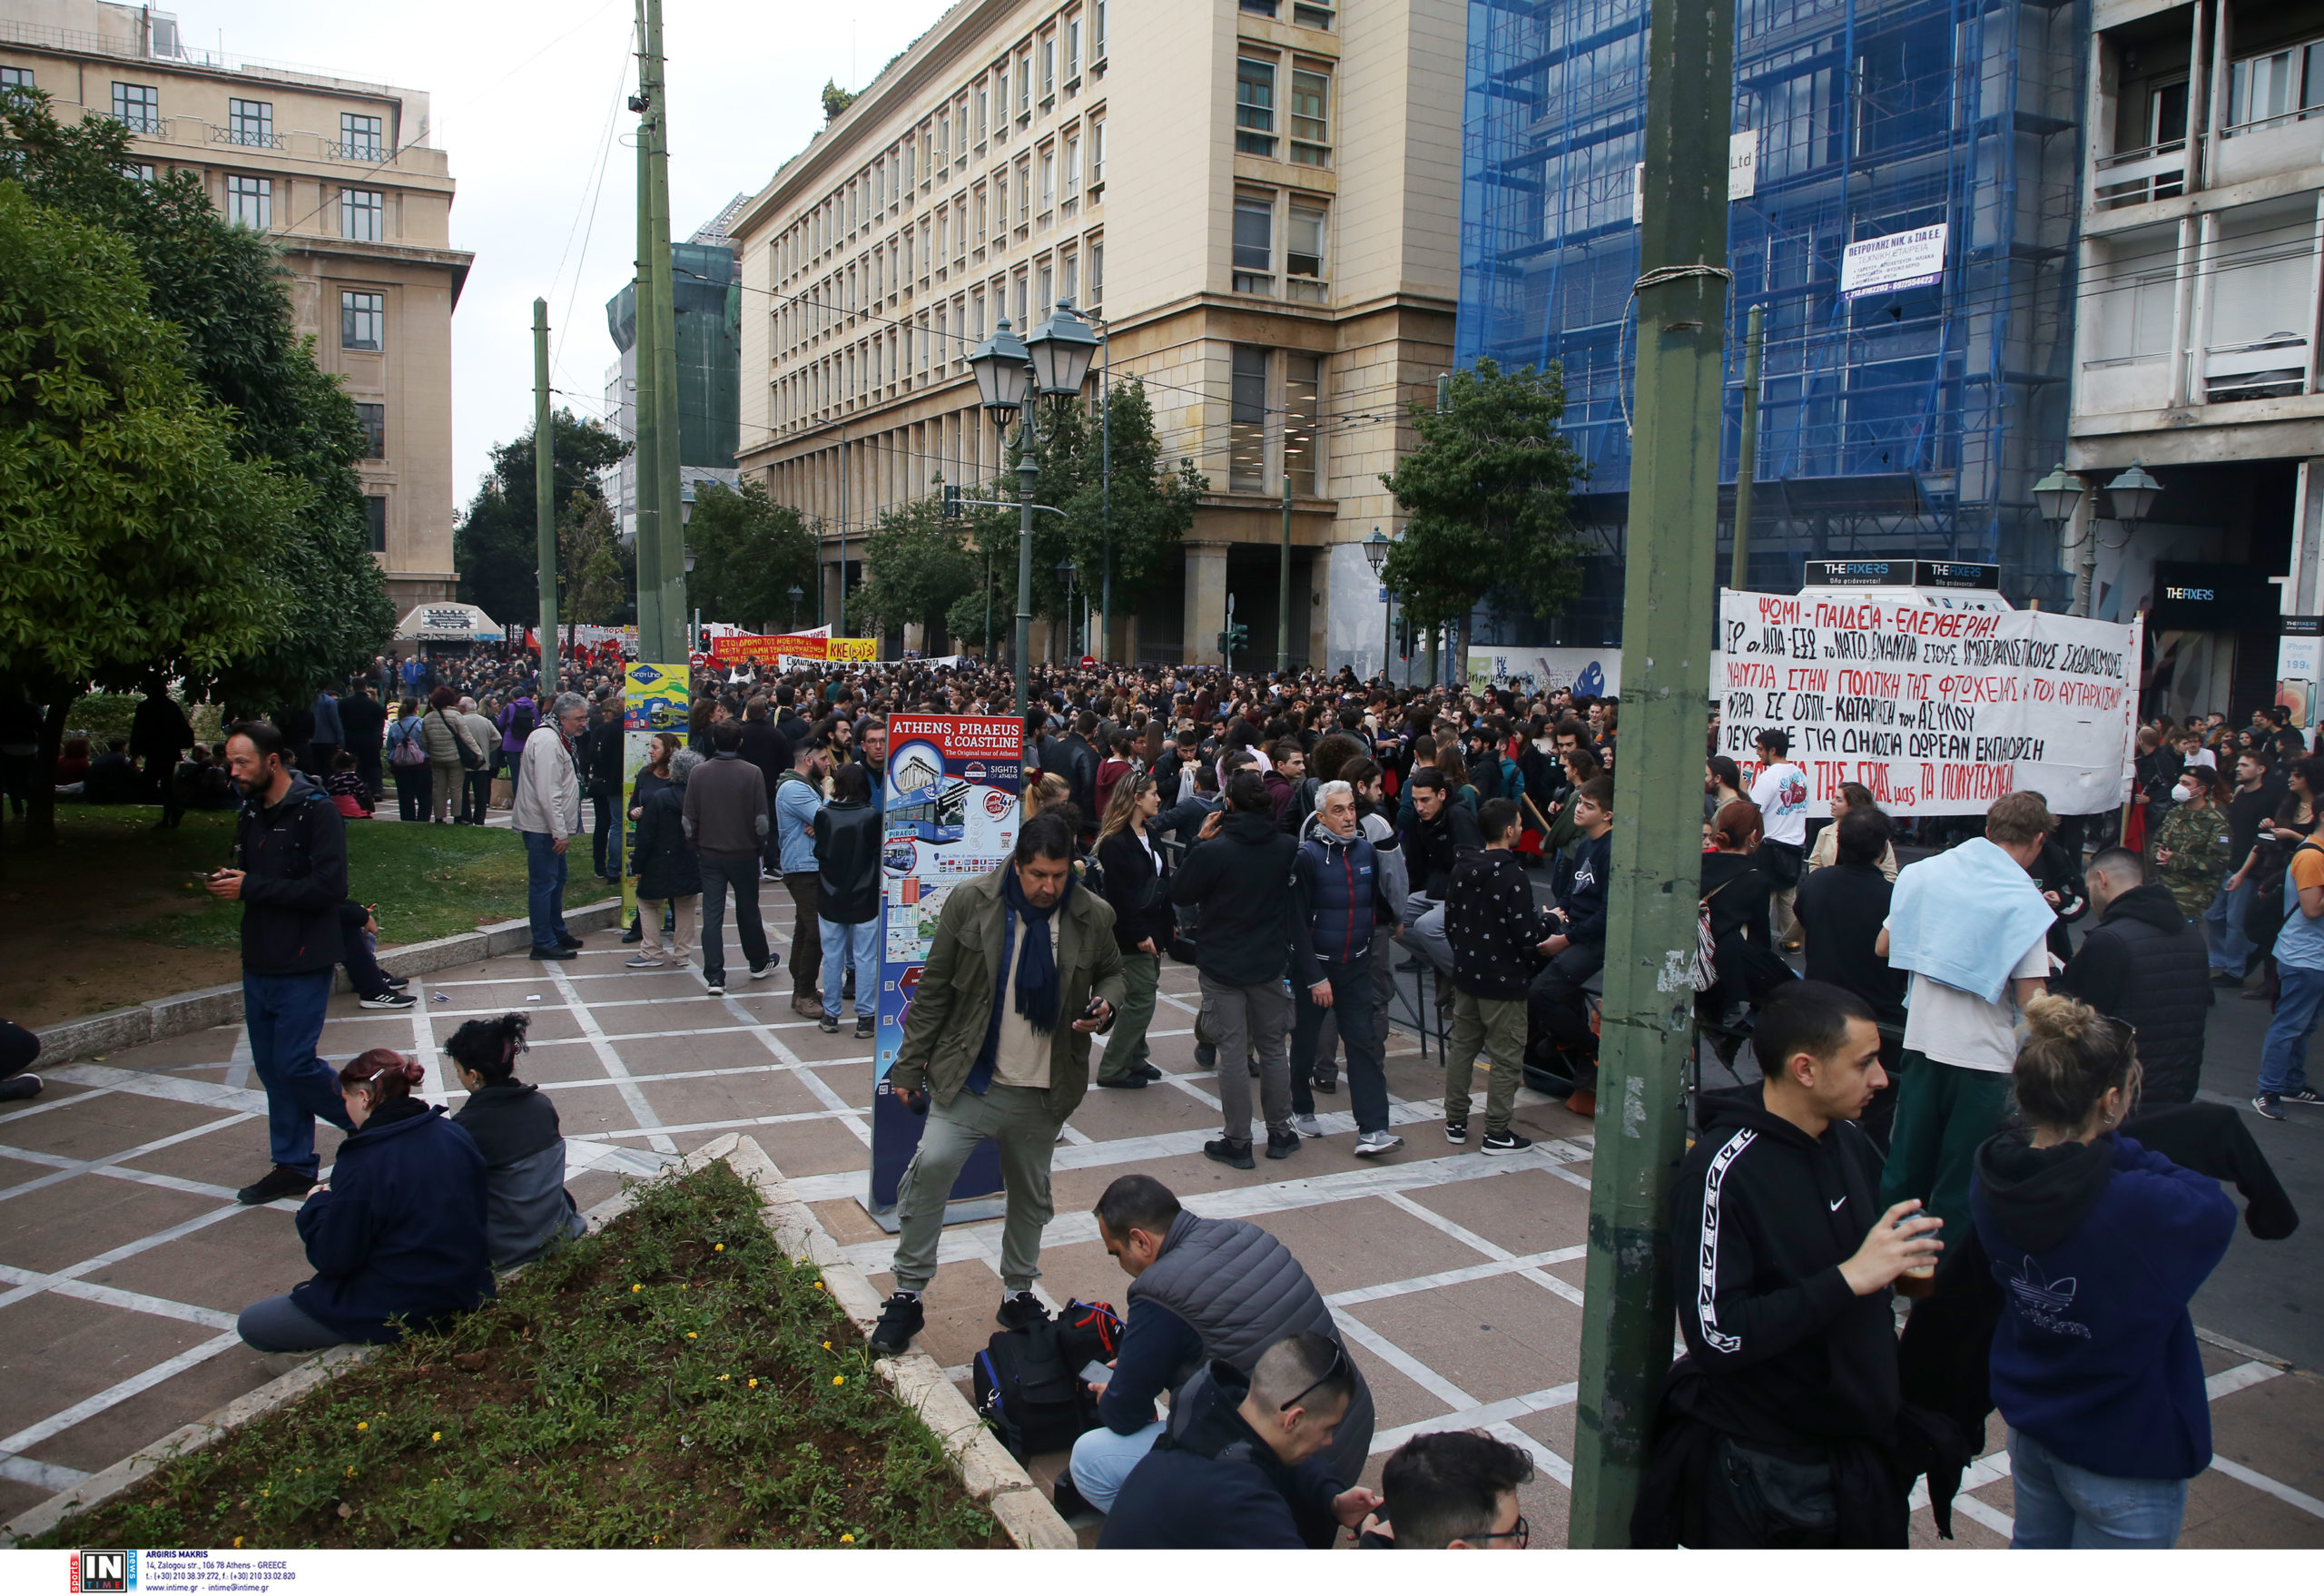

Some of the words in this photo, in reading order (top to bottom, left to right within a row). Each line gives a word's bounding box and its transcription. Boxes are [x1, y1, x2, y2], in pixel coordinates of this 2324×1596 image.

[1730, 153, 1751, 170] Ltd
[1848, 240, 1890, 257] ΠΕΤΡΟΥΛΗΣ
[1907, 235, 1914, 244] &
[1915, 232, 1927, 242] ΣΙΑ
[1858, 251, 1891, 264] ΤΕΧΝΙΚΗ
[1892, 244, 1928, 257] ΕΤΑΙΡΕΙΑ
[1758, 596, 1800, 625] ΨΩΜΙ
[1896, 608, 2001, 638] ΕΛΕΥΘΕΡΙΑ!
[739, 638, 762, 646] ΔΡΟΜΟ
[1835, 631, 1867, 659] ΝΑΤΟ
[1923, 643, 1959, 666] ΣΤΟΥΣ
[1727, 662, 1777, 689] ΝΑΝΤΙΑ
[1787, 668, 1829, 693] ΣΤΗΝ
[1838, 669, 1901, 700] ΠΟΛΤΙΚΗ
[1906, 672, 1932, 701] ΤΗΣ
[1728, 692, 1755, 719] ΝΤΡΑ
[1765, 692, 1786, 721] ΣΕ
[1918, 701, 1975, 732] ΑΣΥΛΟΥ
[892, 721, 955, 736] ATHENS,
[959, 724, 1019, 736] PIRAEUS
[944, 736, 952, 747] &
[954, 736, 1019, 748] COASTLINE
[1805, 727, 1836, 753] ΓΙΑ
[1909, 733, 1970, 761] ΔΩΡΕΑΝ
[957, 749, 980, 757] Original
[990, 765, 1018, 773] SIGHTS
[890, 829, 917, 837] PIRAEUS
[1714, 1154, 1728, 1171] NIKE
[1707, 1187, 1717, 1208] NIKE
[1704, 1227, 1715, 1248] NIKE
[1702, 1266, 1713, 1287] NIKE
